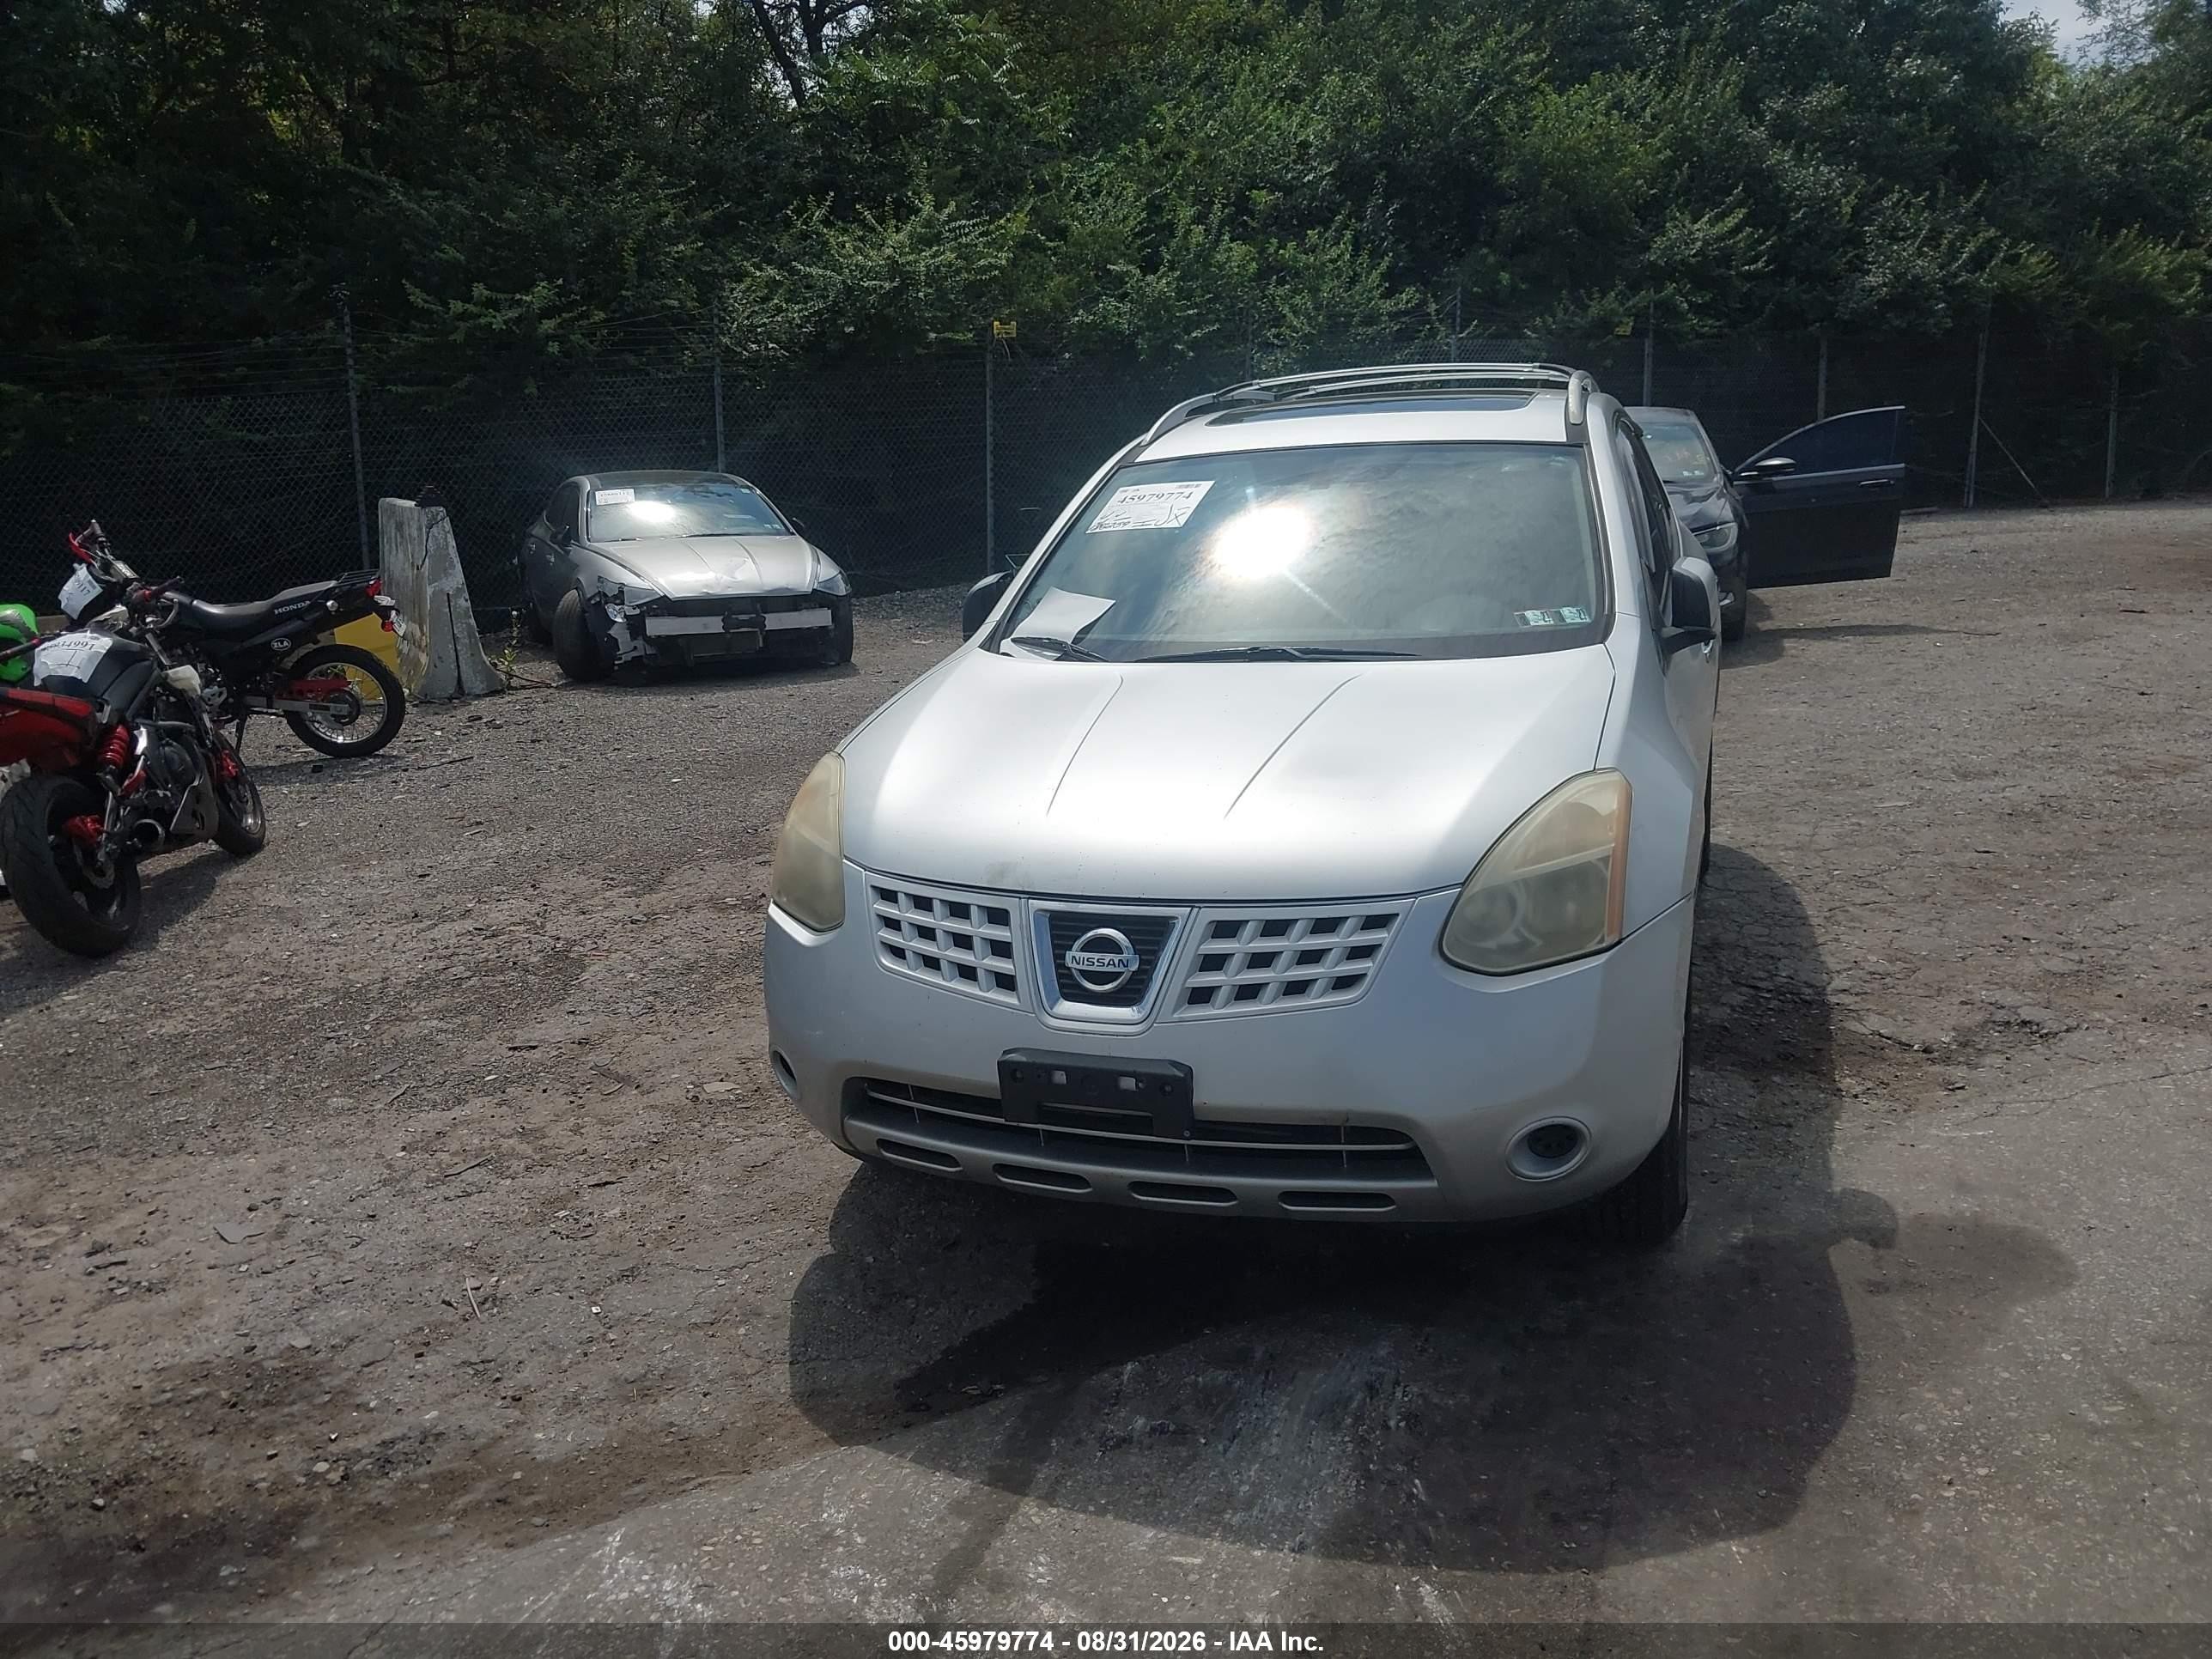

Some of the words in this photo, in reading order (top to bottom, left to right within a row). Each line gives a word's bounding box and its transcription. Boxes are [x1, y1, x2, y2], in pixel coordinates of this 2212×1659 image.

[1118, 492, 1194, 504] 45979774
[274, 600, 311, 615] HONDA
[1071, 956, 1129, 969] NISSAN
